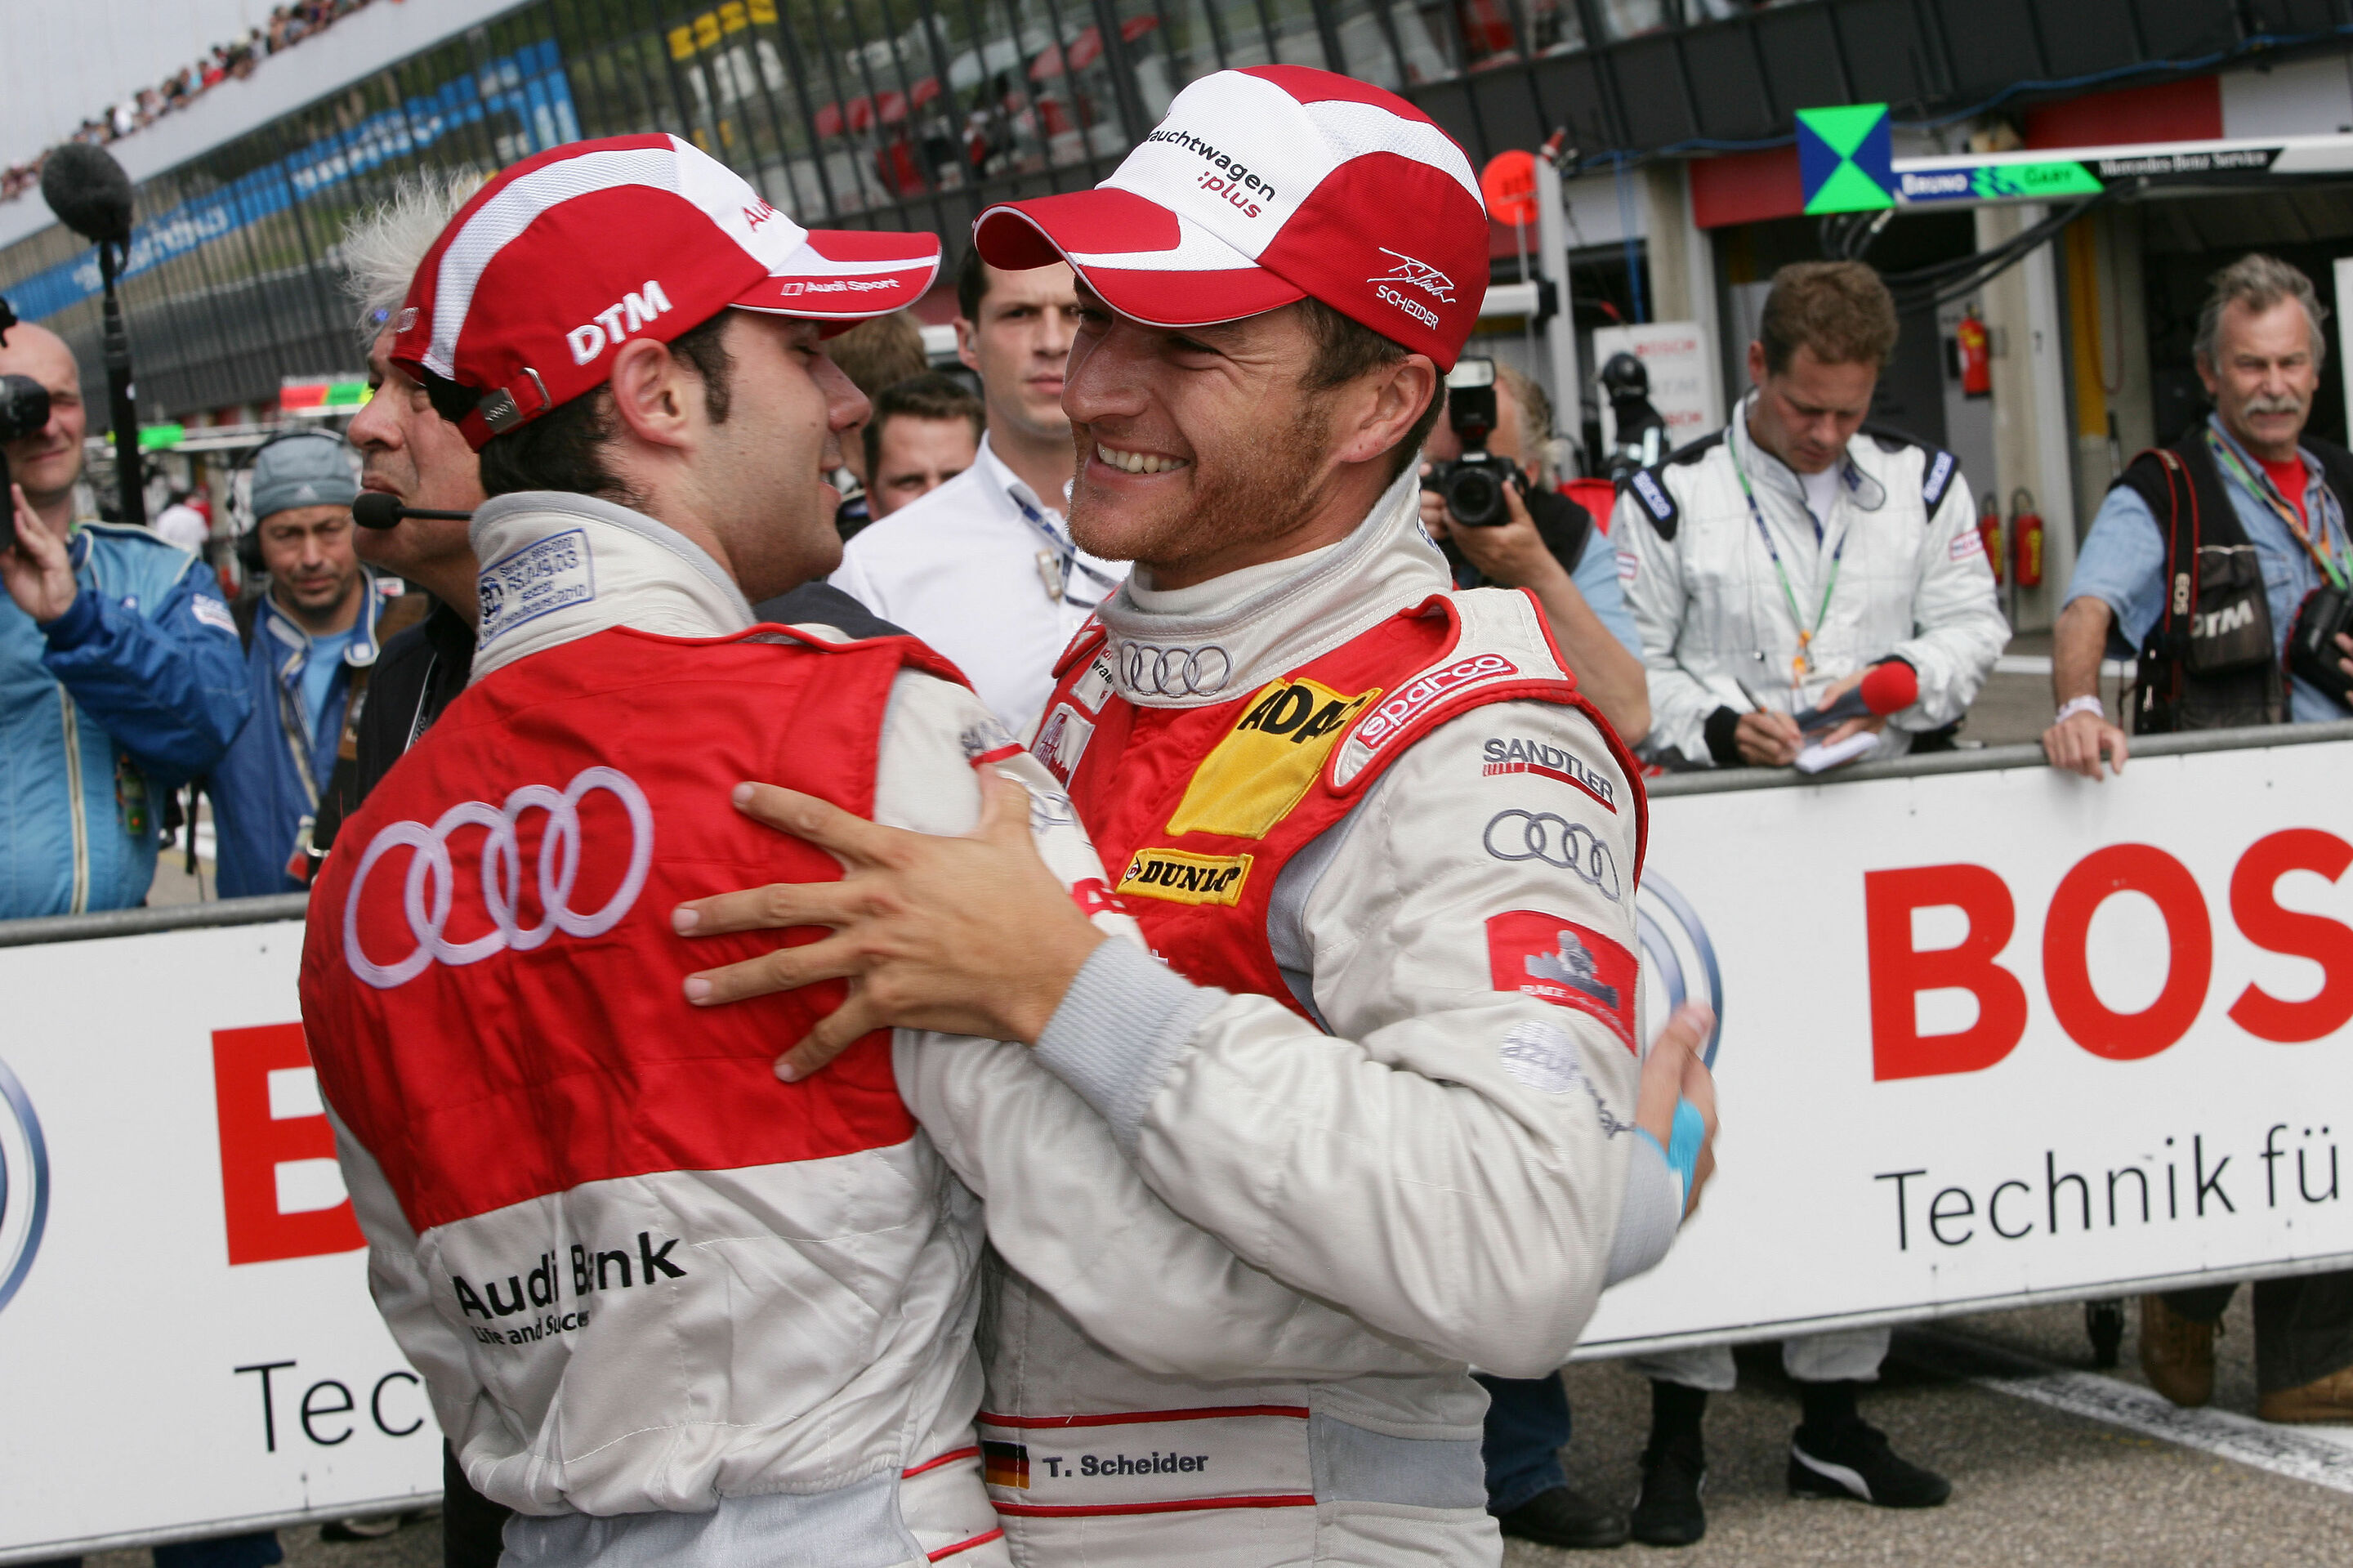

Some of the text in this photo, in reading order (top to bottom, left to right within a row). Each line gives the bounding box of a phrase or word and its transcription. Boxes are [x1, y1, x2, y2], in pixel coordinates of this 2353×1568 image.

[1198, 171, 1261, 218] :plus
[805, 279, 900, 293] Audi Sport
[1376, 284, 1439, 330] SCHEIDER
[565, 279, 673, 366] DTM
[2173, 572, 2191, 615] EOS
[2191, 599, 2255, 639] DTM
[1484, 738, 1614, 805] SANDTLER
[1873, 1124, 2339, 1252] Technik fü
[453, 1250, 559, 1320] Audi
[507, 1317, 543, 1345] and
[234, 1360, 425, 1454] Tec
[1042, 1451, 1209, 1477] T. Scheider
